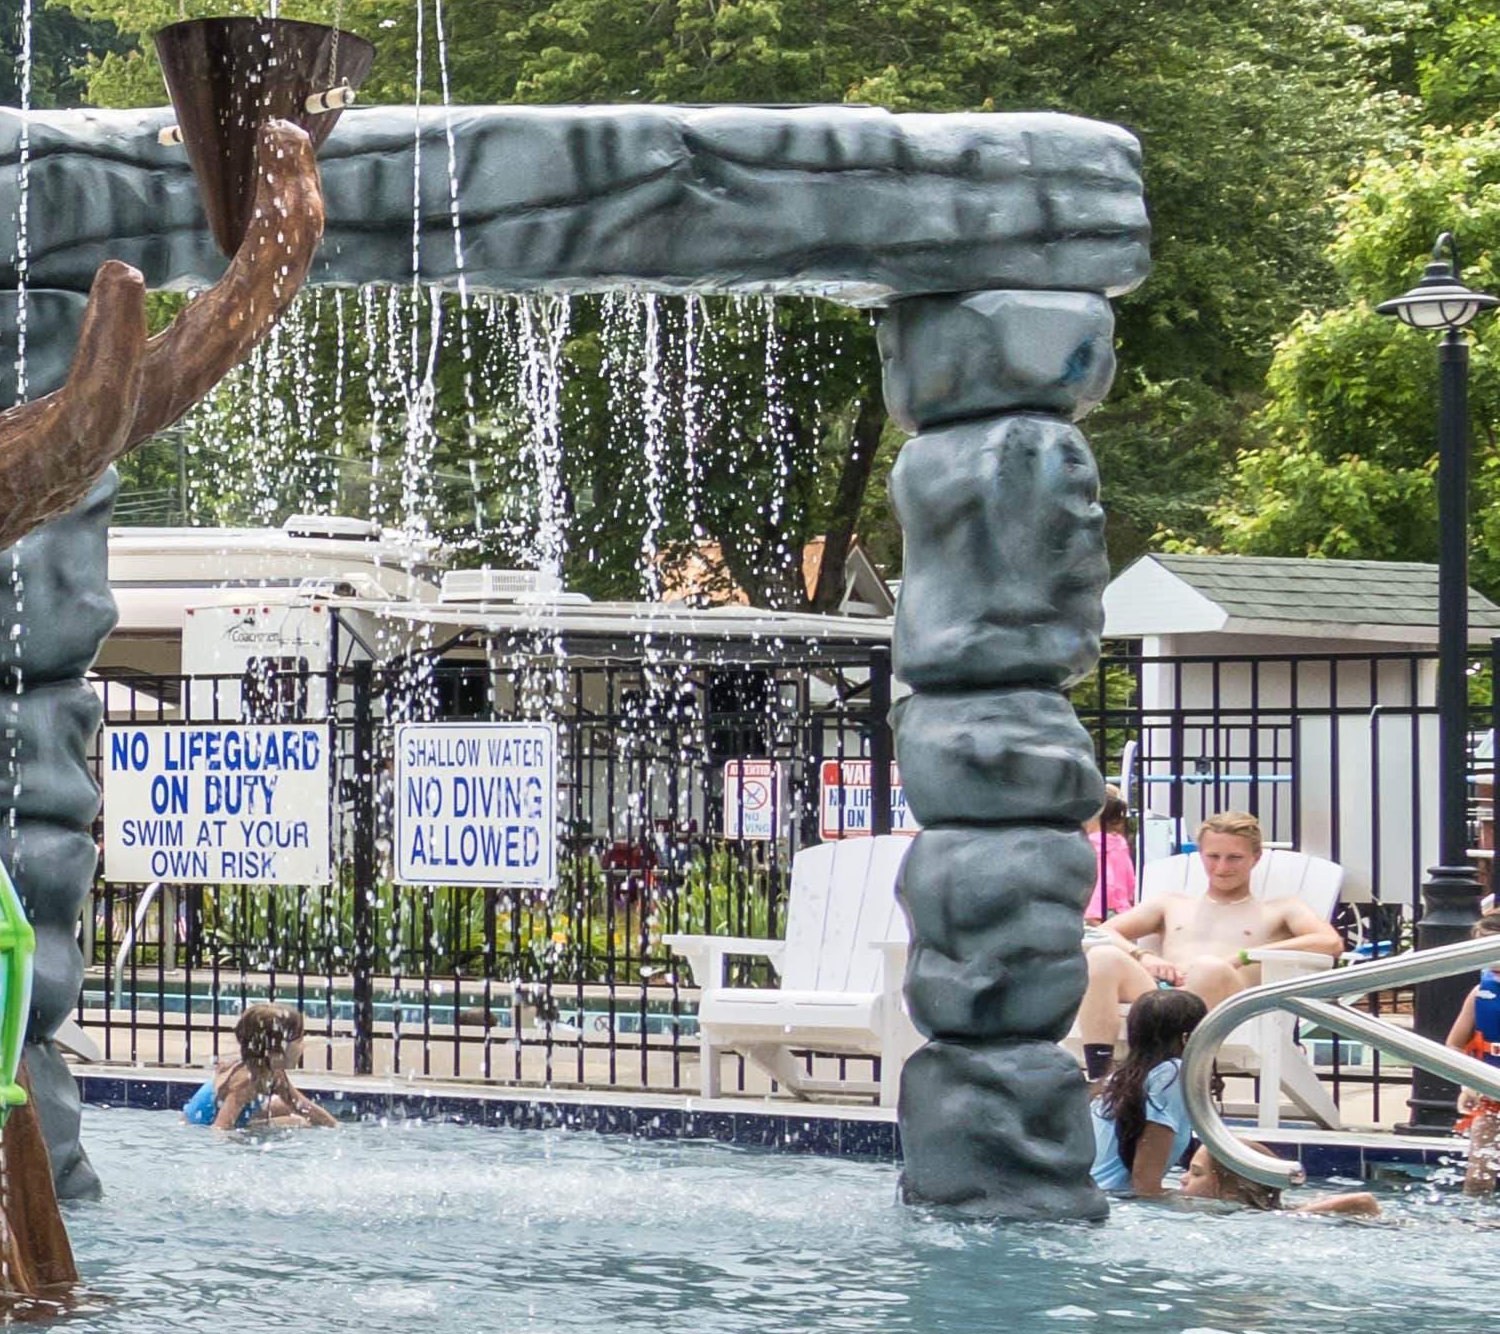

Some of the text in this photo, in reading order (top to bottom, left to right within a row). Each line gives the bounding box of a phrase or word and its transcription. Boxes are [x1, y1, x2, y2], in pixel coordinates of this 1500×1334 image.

[111, 731, 320, 771] NO LIFEGUARD
[407, 738, 544, 767] SHALLOW WATER
[151, 775, 278, 815] ON DUTY
[408, 776, 542, 819] NO DIVING
[744, 812, 759, 821] NO
[847, 809, 865, 828] ON
[122, 820, 309, 848] SWIM AT YOUR
[410, 824, 540, 867] ALLOWED
[151, 850, 277, 879] OWN RISK
